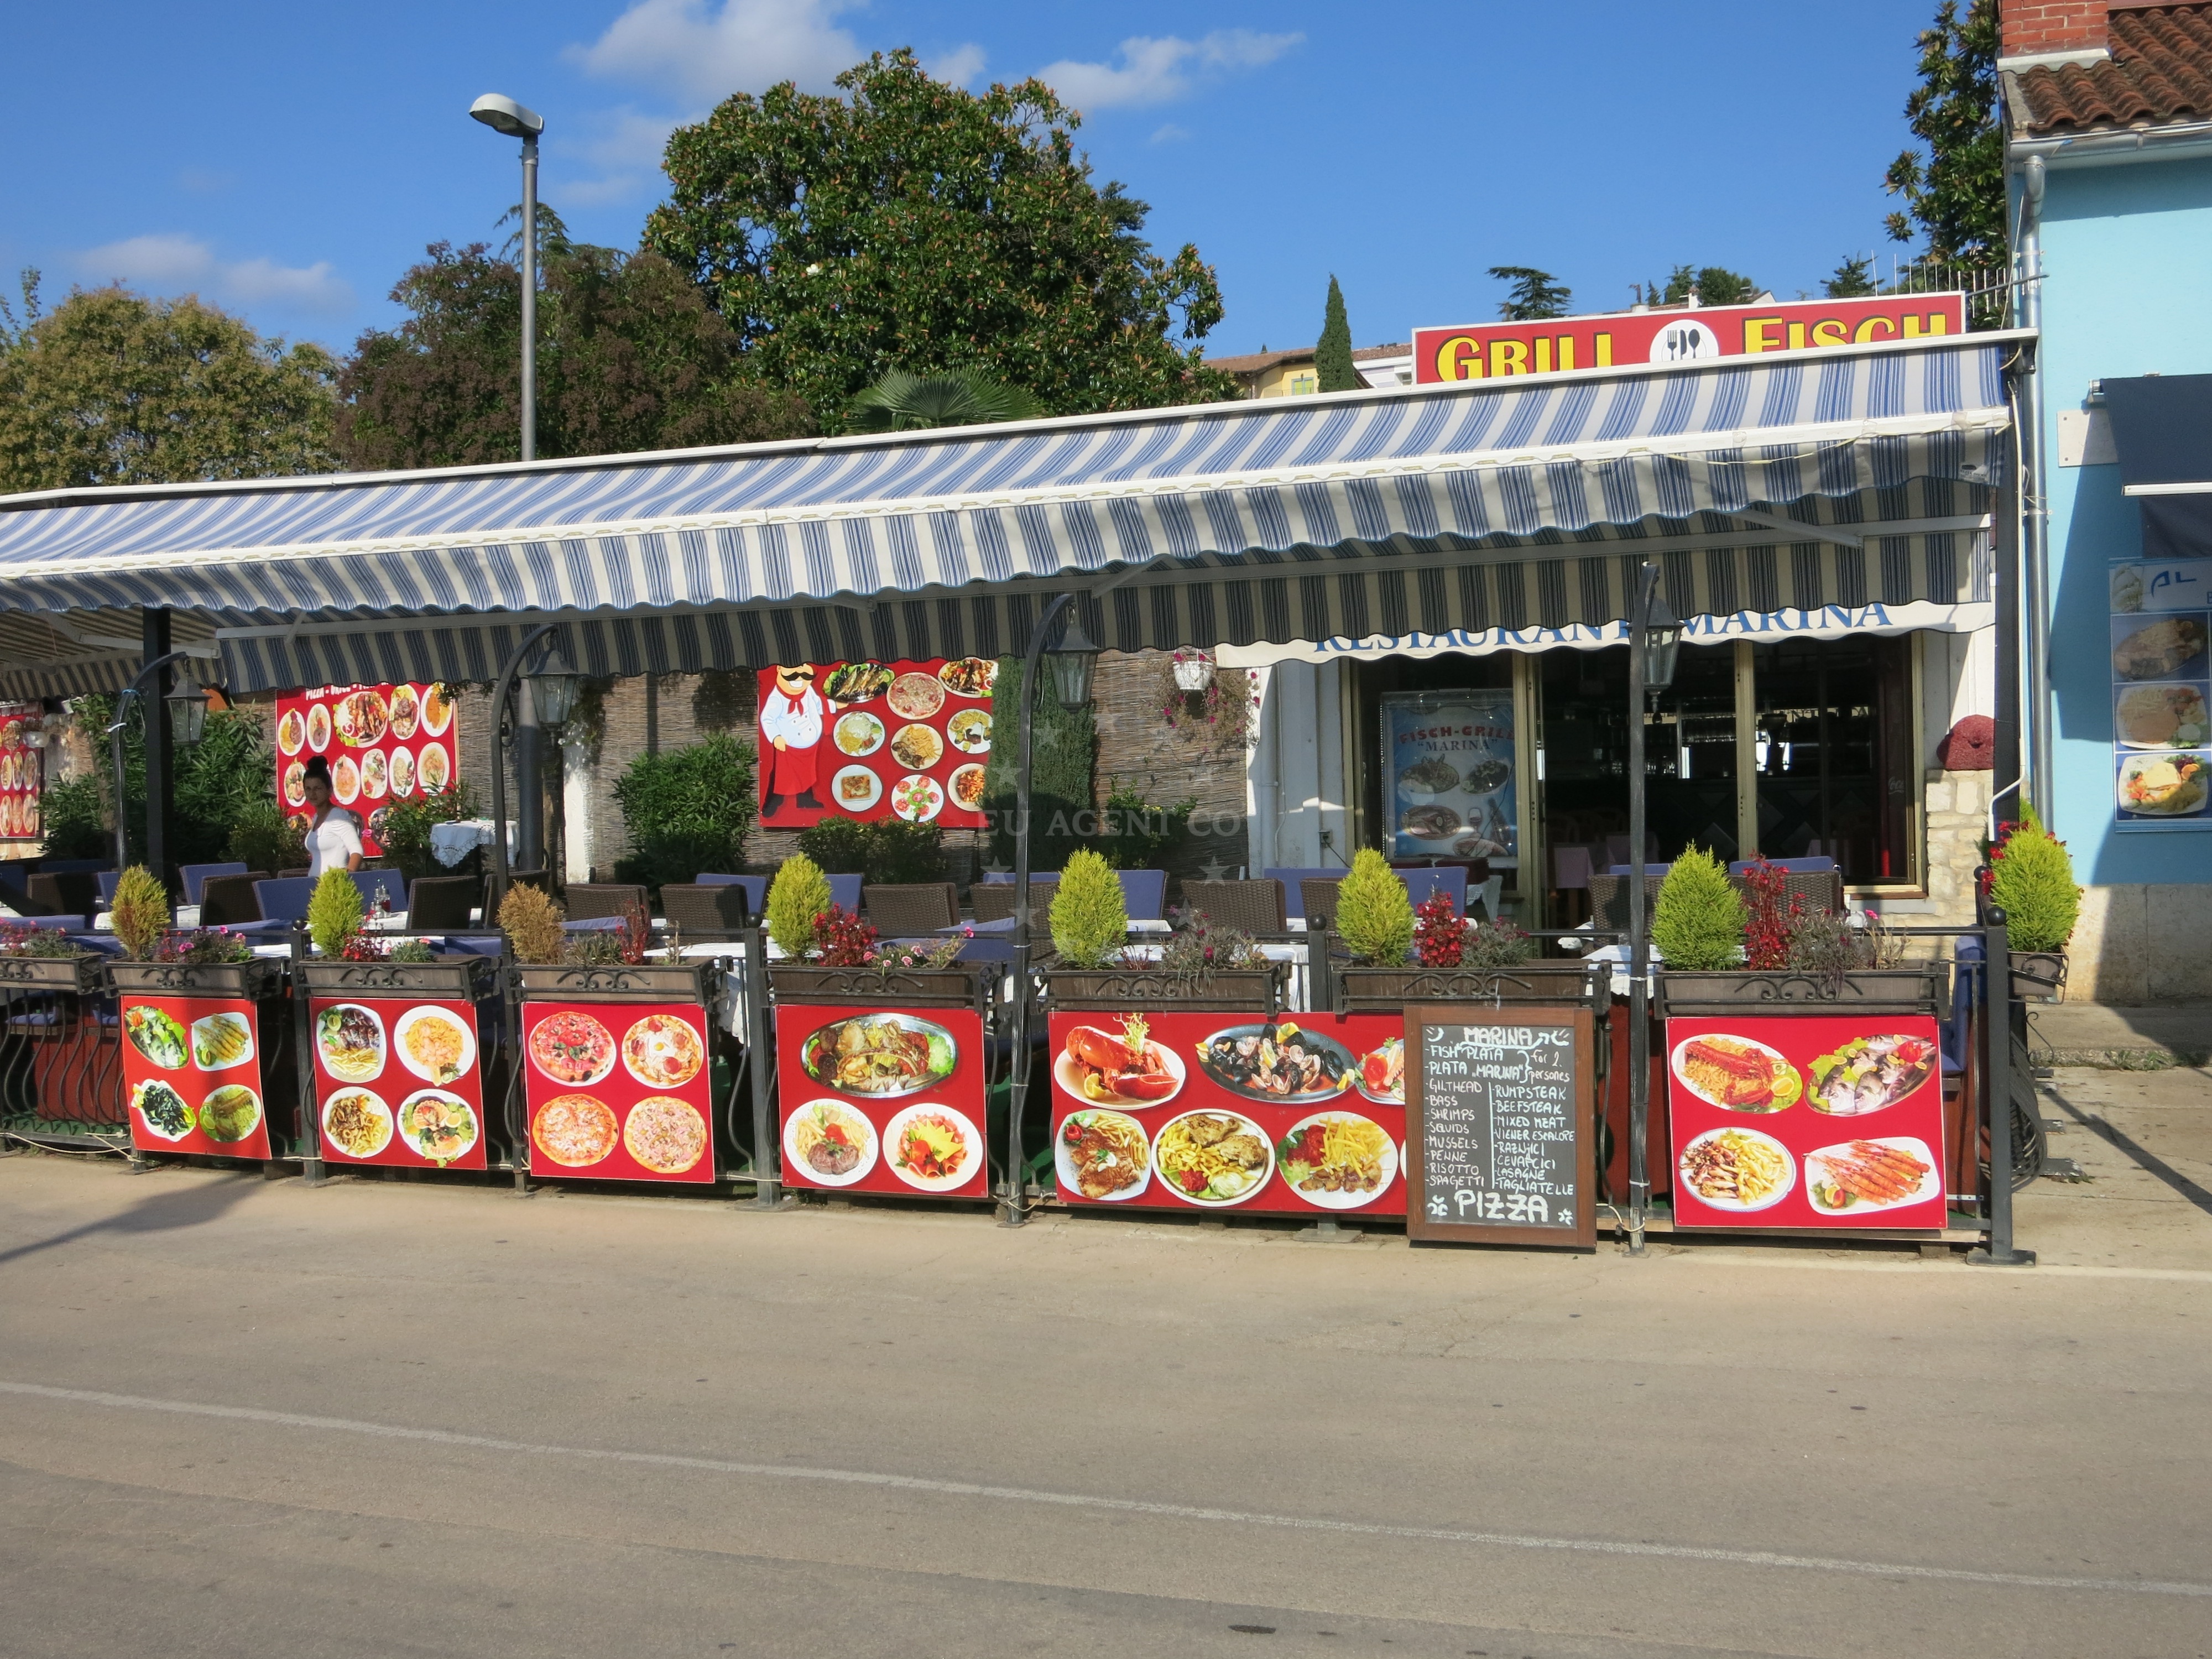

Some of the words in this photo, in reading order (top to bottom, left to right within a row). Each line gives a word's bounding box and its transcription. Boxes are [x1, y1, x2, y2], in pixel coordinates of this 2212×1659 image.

[1463, 1026, 1532, 1046] MARINA
[1530, 1049, 1547, 1063] for
[1528, 1070, 1570, 1084] persones
[1533, 1117, 1566, 1129] MEAT
[1454, 1189, 1549, 1224] PIZZA
